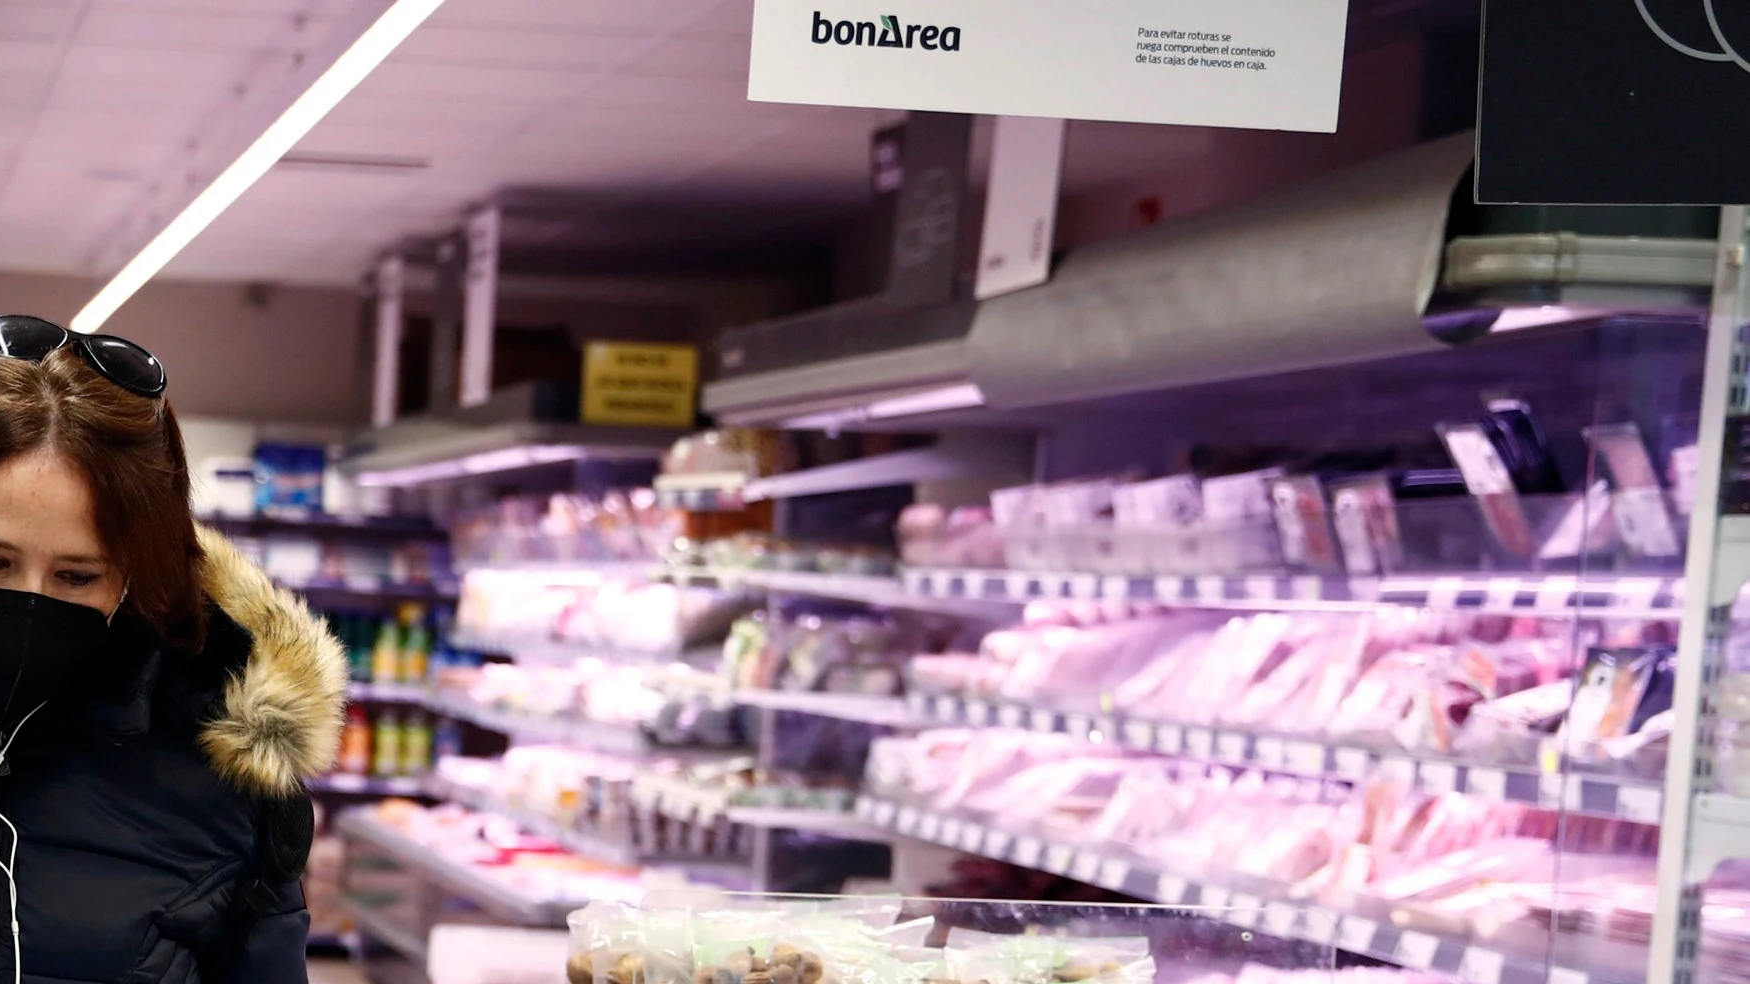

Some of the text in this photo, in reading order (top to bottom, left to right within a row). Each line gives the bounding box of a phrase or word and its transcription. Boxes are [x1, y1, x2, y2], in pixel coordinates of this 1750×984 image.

[1138, 27, 1232, 43] Para evitar roturas se
[1136, 41, 1276, 58] ruega comprueben el contenido
[1135, 54, 1267, 72] de las cajas de huevos en caja.
